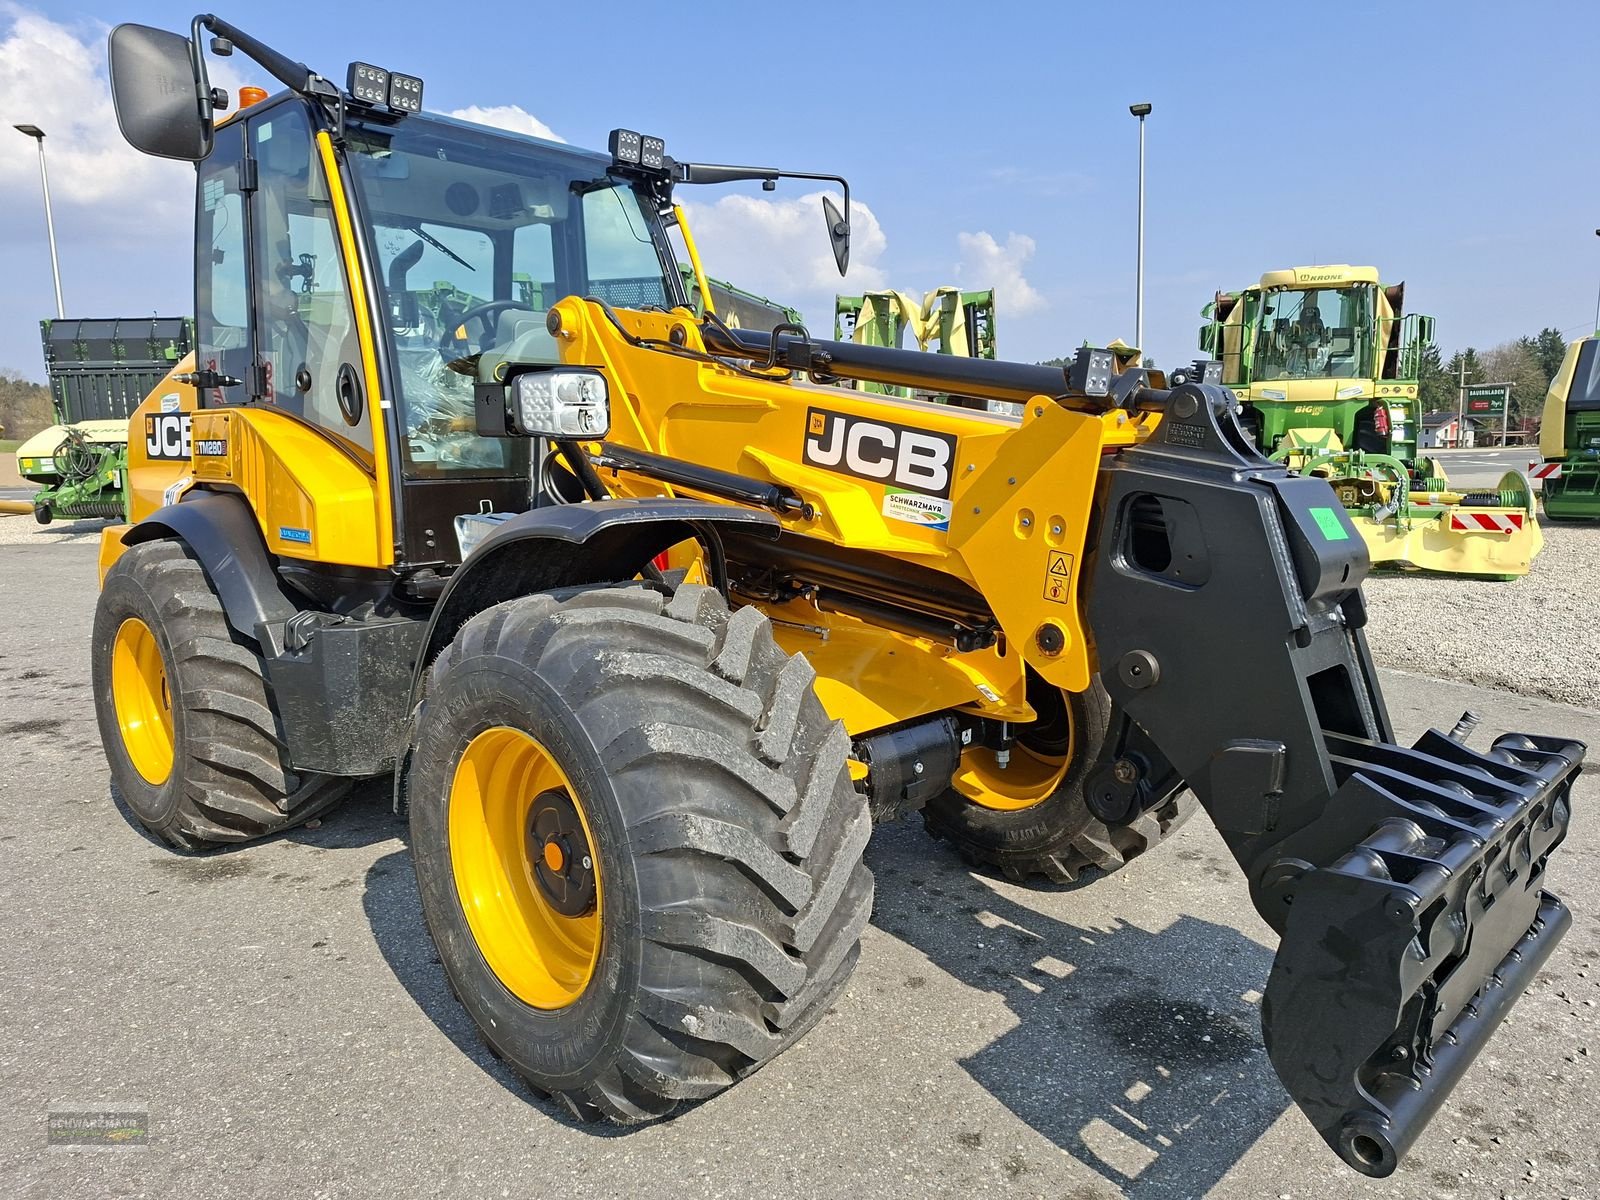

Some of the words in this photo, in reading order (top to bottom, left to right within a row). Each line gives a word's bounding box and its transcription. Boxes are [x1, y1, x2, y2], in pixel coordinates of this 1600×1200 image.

[807, 416, 950, 491] JCB
[890, 495, 942, 513] SCHWARZMAYR
[890, 503, 920, 513] LANDTECHNIK
